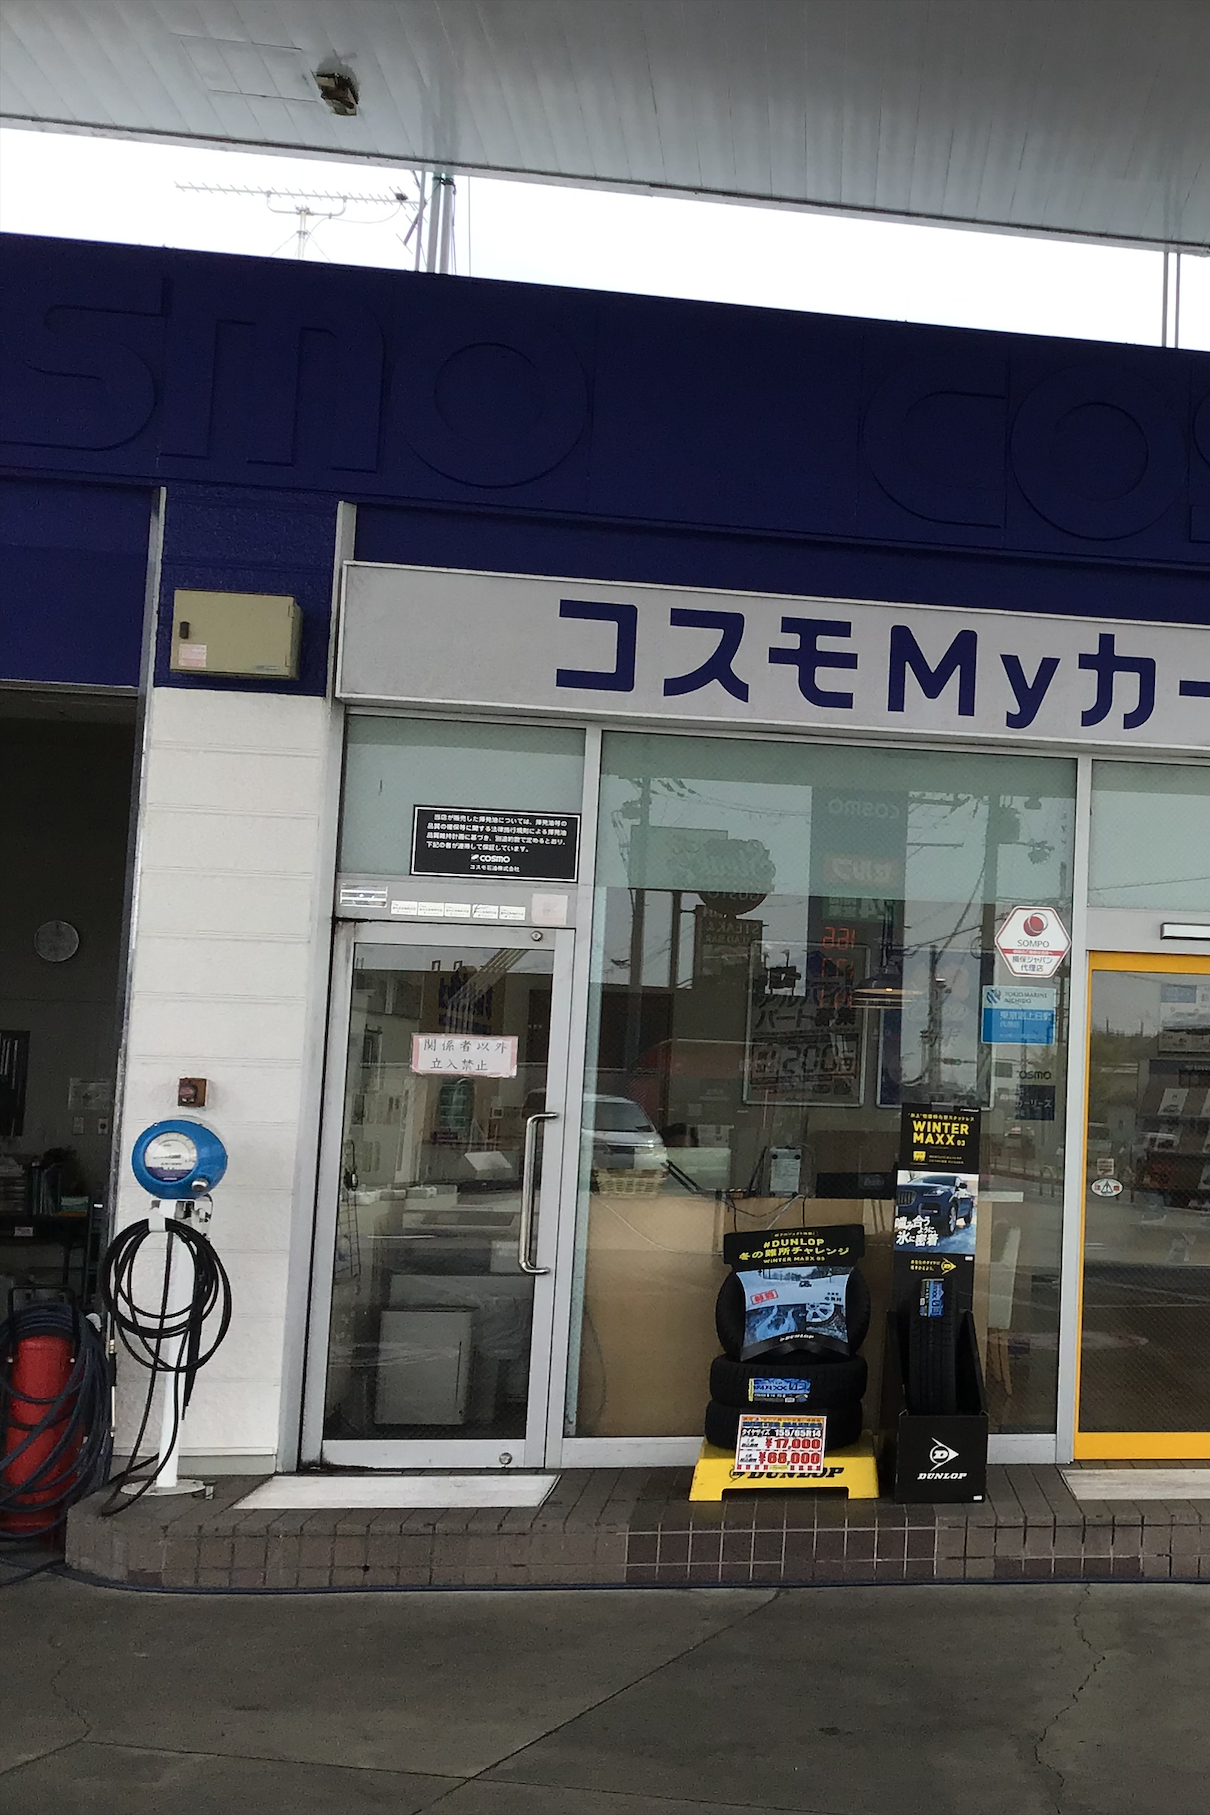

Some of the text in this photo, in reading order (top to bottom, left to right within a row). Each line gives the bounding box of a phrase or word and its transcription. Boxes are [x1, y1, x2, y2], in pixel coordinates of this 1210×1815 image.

[479, 854, 511, 863] COSMO
[470, 864, 520, 872] コスモ石油株式会社
[1017, 939, 1050, 948] SOMPO
[1020, 964, 1044, 972] 代理店
[430, 1058, 488, 1072] 立入禁止
[913, 1120, 969, 1135] WINTER
[913, 1132, 966, 1147] MAXX 03
[763, 1238, 825, 1249] #DUNLOP
[739, 1247, 850, 1261] 冬の難所チャレンジ
[917, 1472, 967, 1480] DUNLOP
